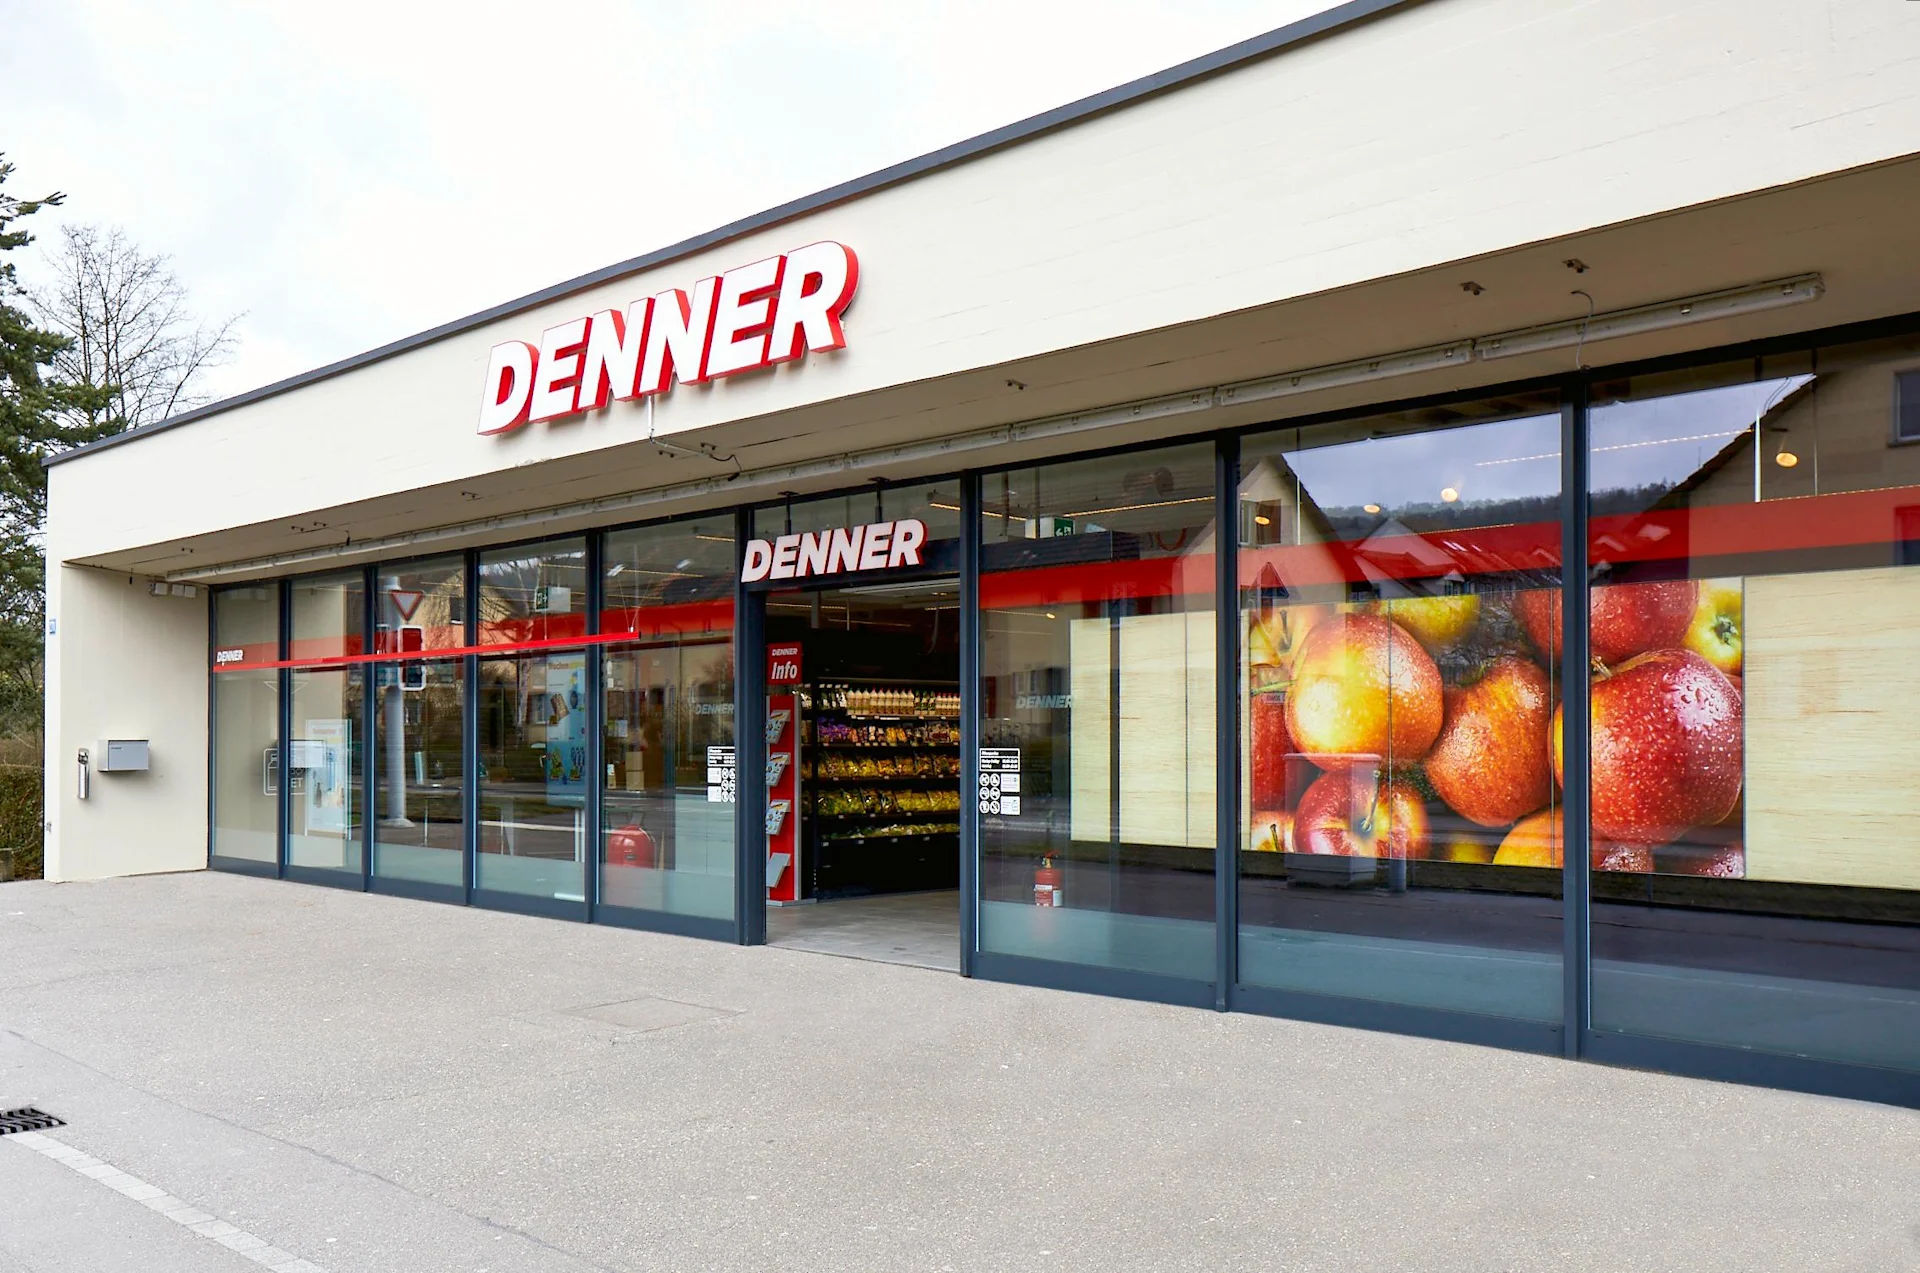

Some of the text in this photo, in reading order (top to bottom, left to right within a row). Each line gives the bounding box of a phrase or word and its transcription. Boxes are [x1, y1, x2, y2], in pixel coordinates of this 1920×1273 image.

[477, 240, 860, 436] DENNER
[741, 519, 928, 584] DENNER
[216, 649, 243, 662] DENNER
[772, 647, 798, 656] DENNER
[771, 660, 798, 680] Info
[695, 703, 734, 715] DENNER
[1015, 694, 1074, 709] DENNER
